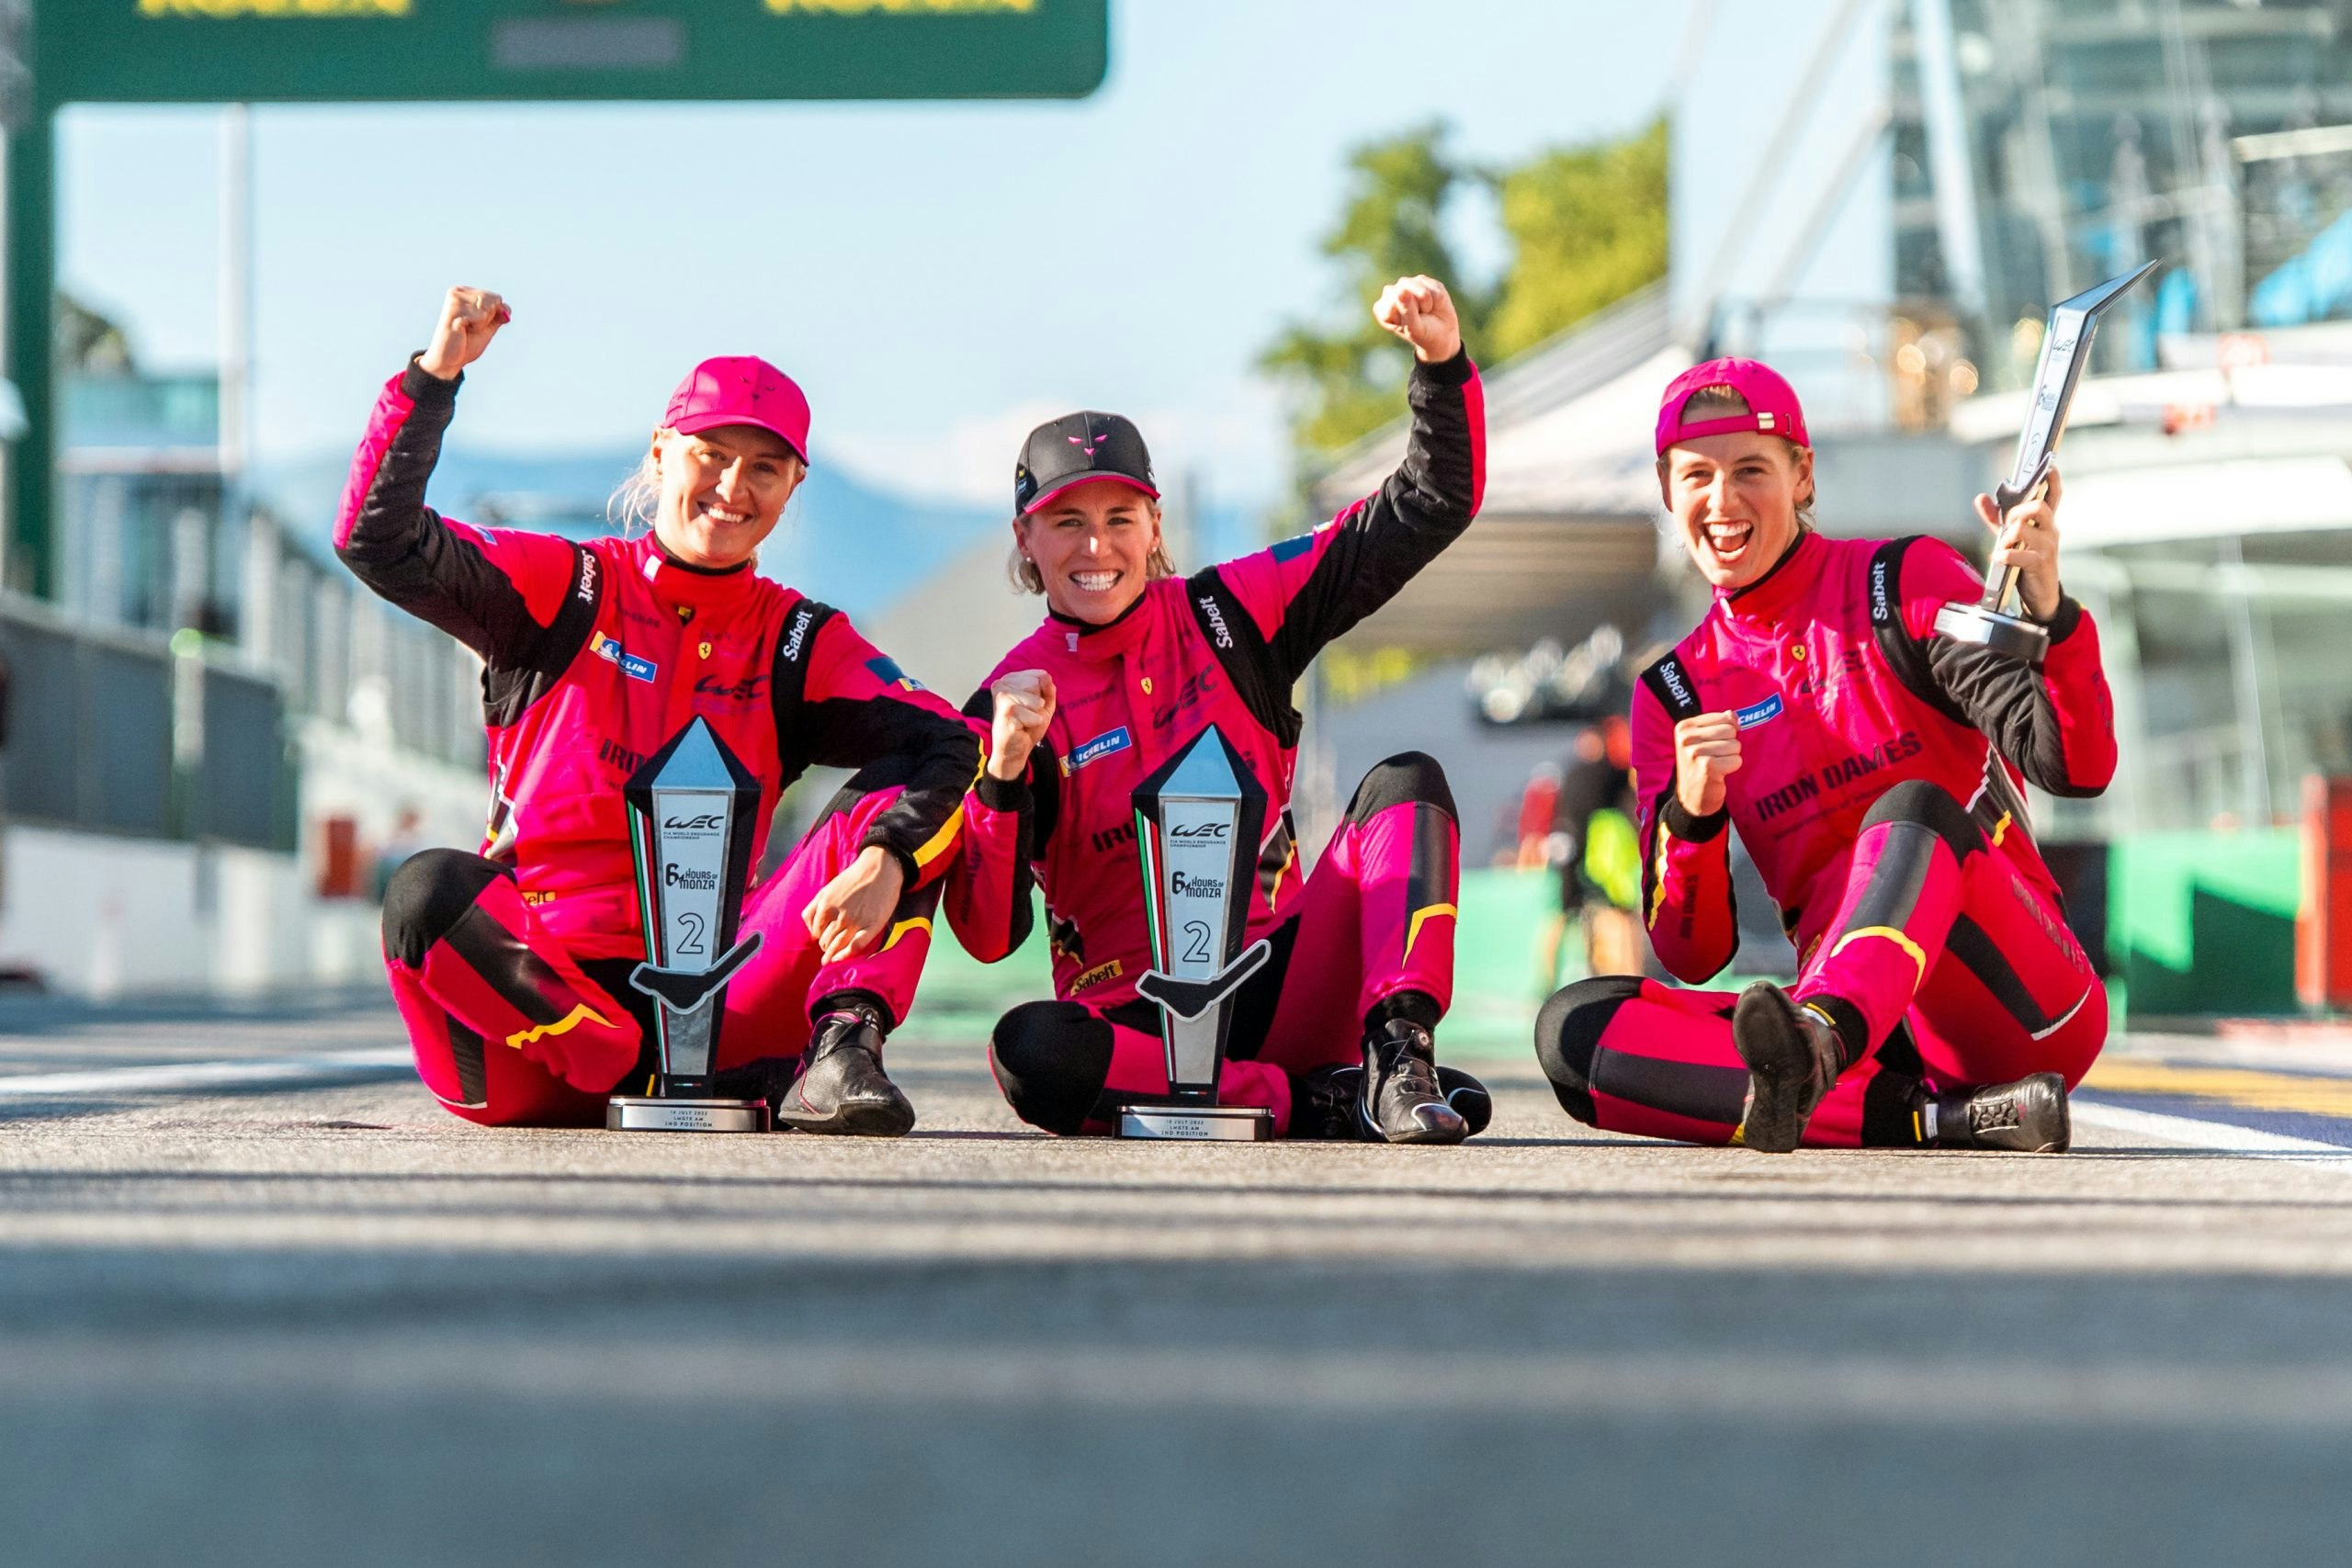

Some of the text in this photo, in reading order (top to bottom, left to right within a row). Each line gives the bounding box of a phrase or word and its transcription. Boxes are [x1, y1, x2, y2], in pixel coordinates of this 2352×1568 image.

[578, 549, 596, 603] Sabelt
[1872, 561, 1888, 621] Sabelt
[783, 610, 813, 661] Sabelt
[1199, 595, 1233, 649] Sabelt
[1660, 661, 1691, 707] Sabelt
[1738, 702, 1777, 724] CHELIN
[1755, 773, 1819, 822] IRON
[1823, 731, 1922, 789] DAMES
[664, 815, 725, 829] WEC
[1170, 823, 1231, 838] WEC
[665, 863, 680, 887] 6
[685, 868, 712, 880] HOURS
[679, 879, 716, 890] MONZA
[1172, 871, 1186, 896] 6
[1192, 875, 1218, 887] HOURS
[1186, 887, 1222, 898] MONZA
[676, 912, 705, 954] 2
[1182, 920, 1211, 963] 2
[1074, 964, 1117, 993] Sabelt
